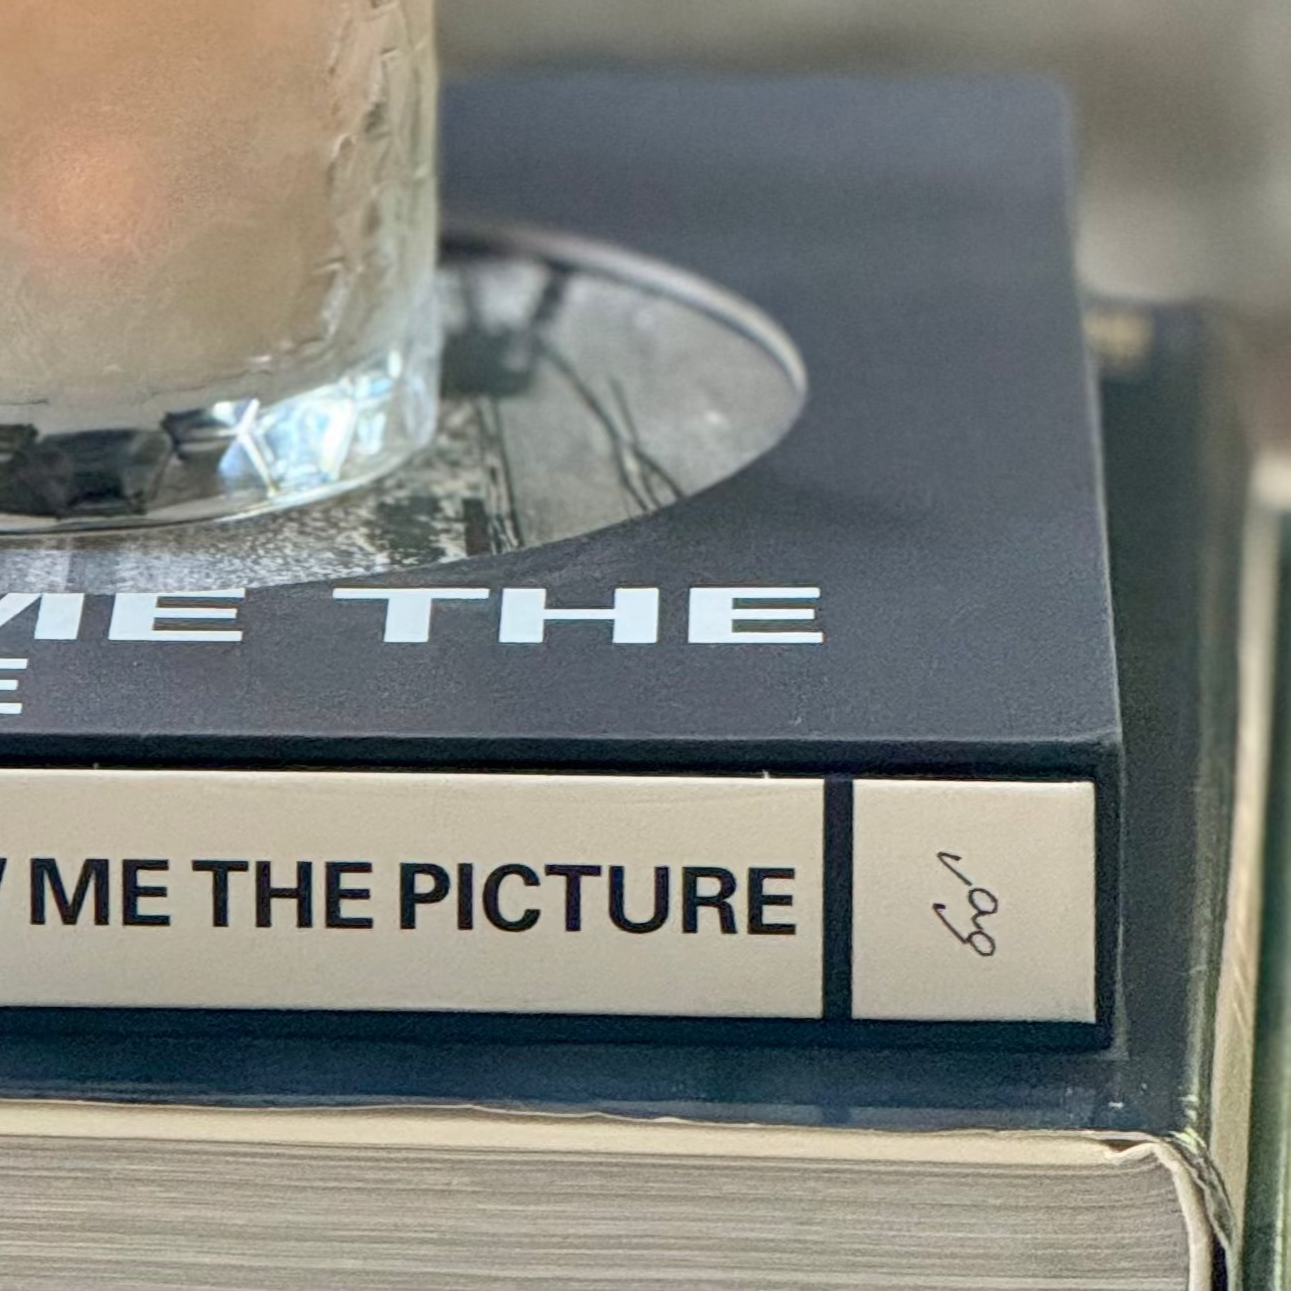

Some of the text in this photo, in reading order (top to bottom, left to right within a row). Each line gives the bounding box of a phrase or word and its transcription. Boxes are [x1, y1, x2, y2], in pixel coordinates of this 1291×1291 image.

[332, 586, 824, 644] THE
[30, 857, 171, 927] ME
[191, 859, 374, 930] THE
[399, 862, 797, 937] PICTURE
